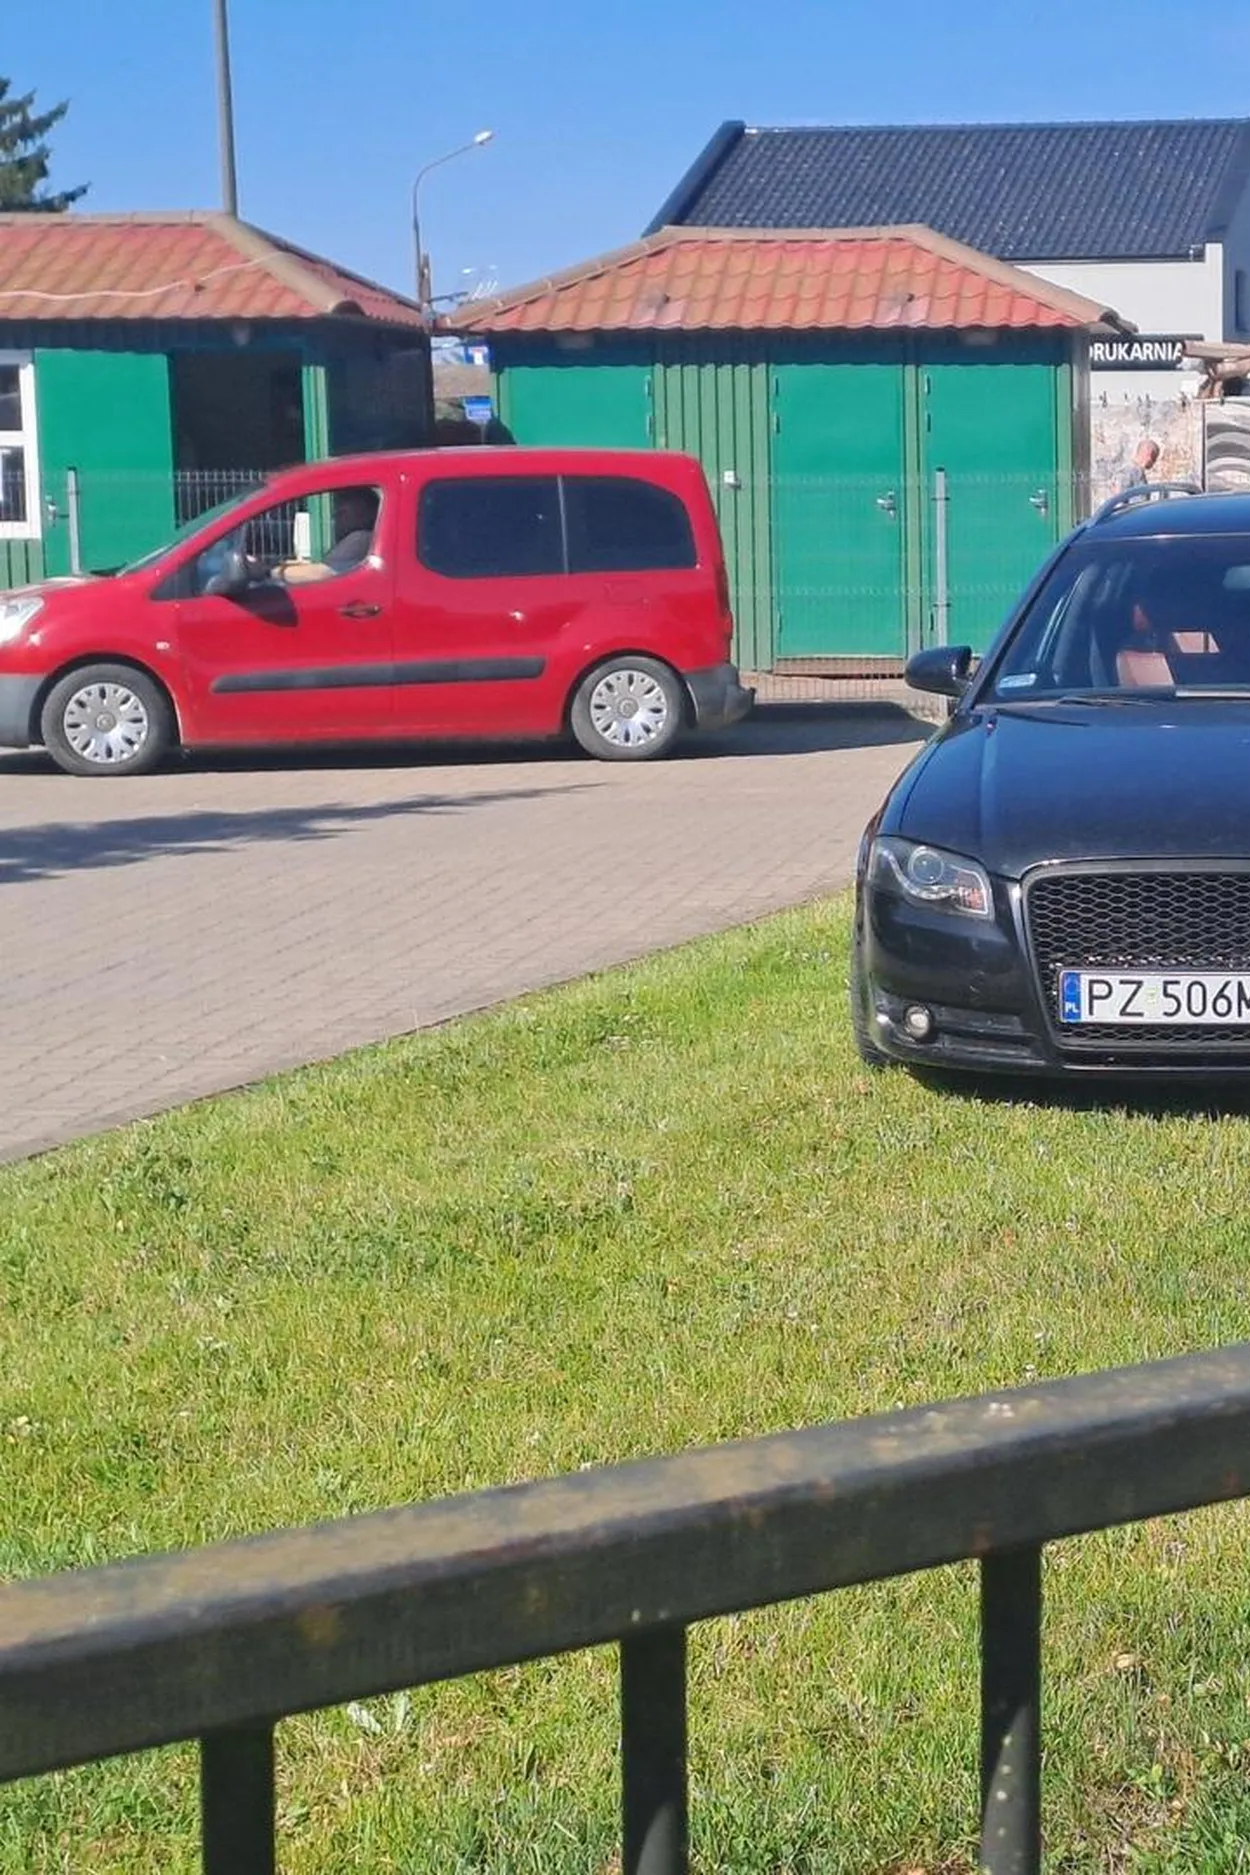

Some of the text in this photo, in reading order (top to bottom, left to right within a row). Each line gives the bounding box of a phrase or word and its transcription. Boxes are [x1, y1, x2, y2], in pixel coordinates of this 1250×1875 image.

[1089, 342, 1183, 361] RUKARNIA
[1065, 1002, 1079, 1013] PL
[1087, 979, 1145, 1017] PZ
